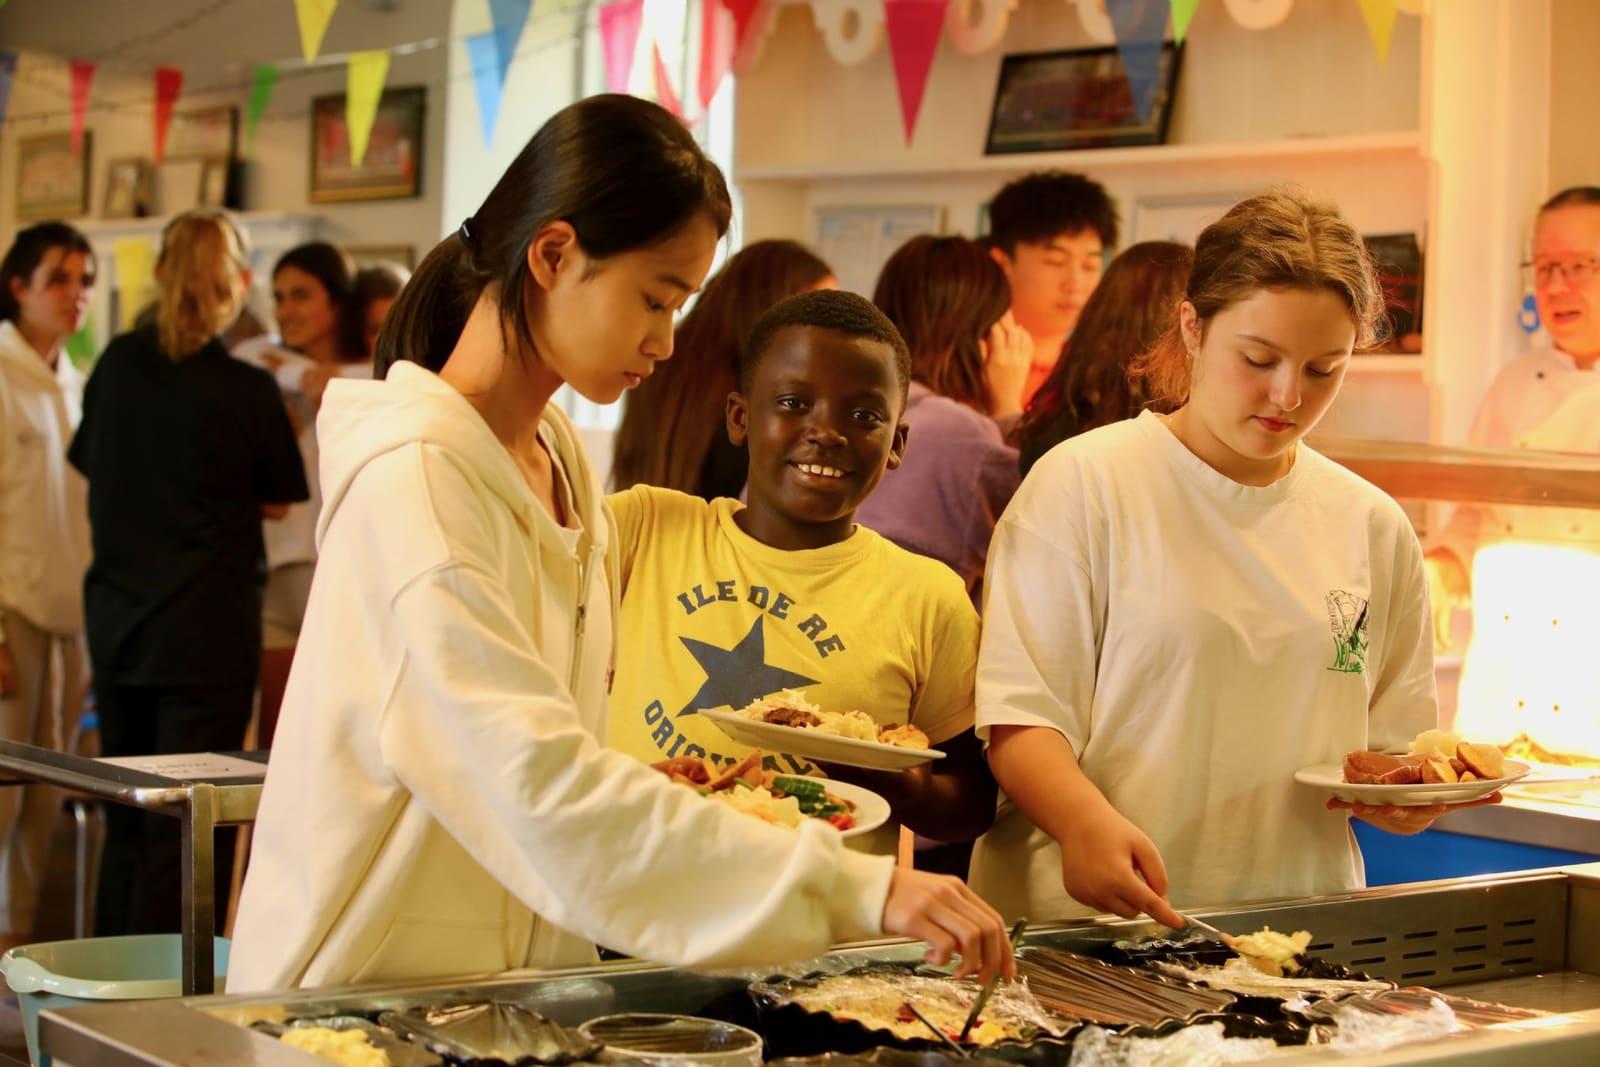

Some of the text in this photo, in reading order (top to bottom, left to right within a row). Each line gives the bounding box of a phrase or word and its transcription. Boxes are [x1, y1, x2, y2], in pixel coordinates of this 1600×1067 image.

[677, 580, 846, 659] ILE DE RE
[644, 699, 814, 776] ORIAL
